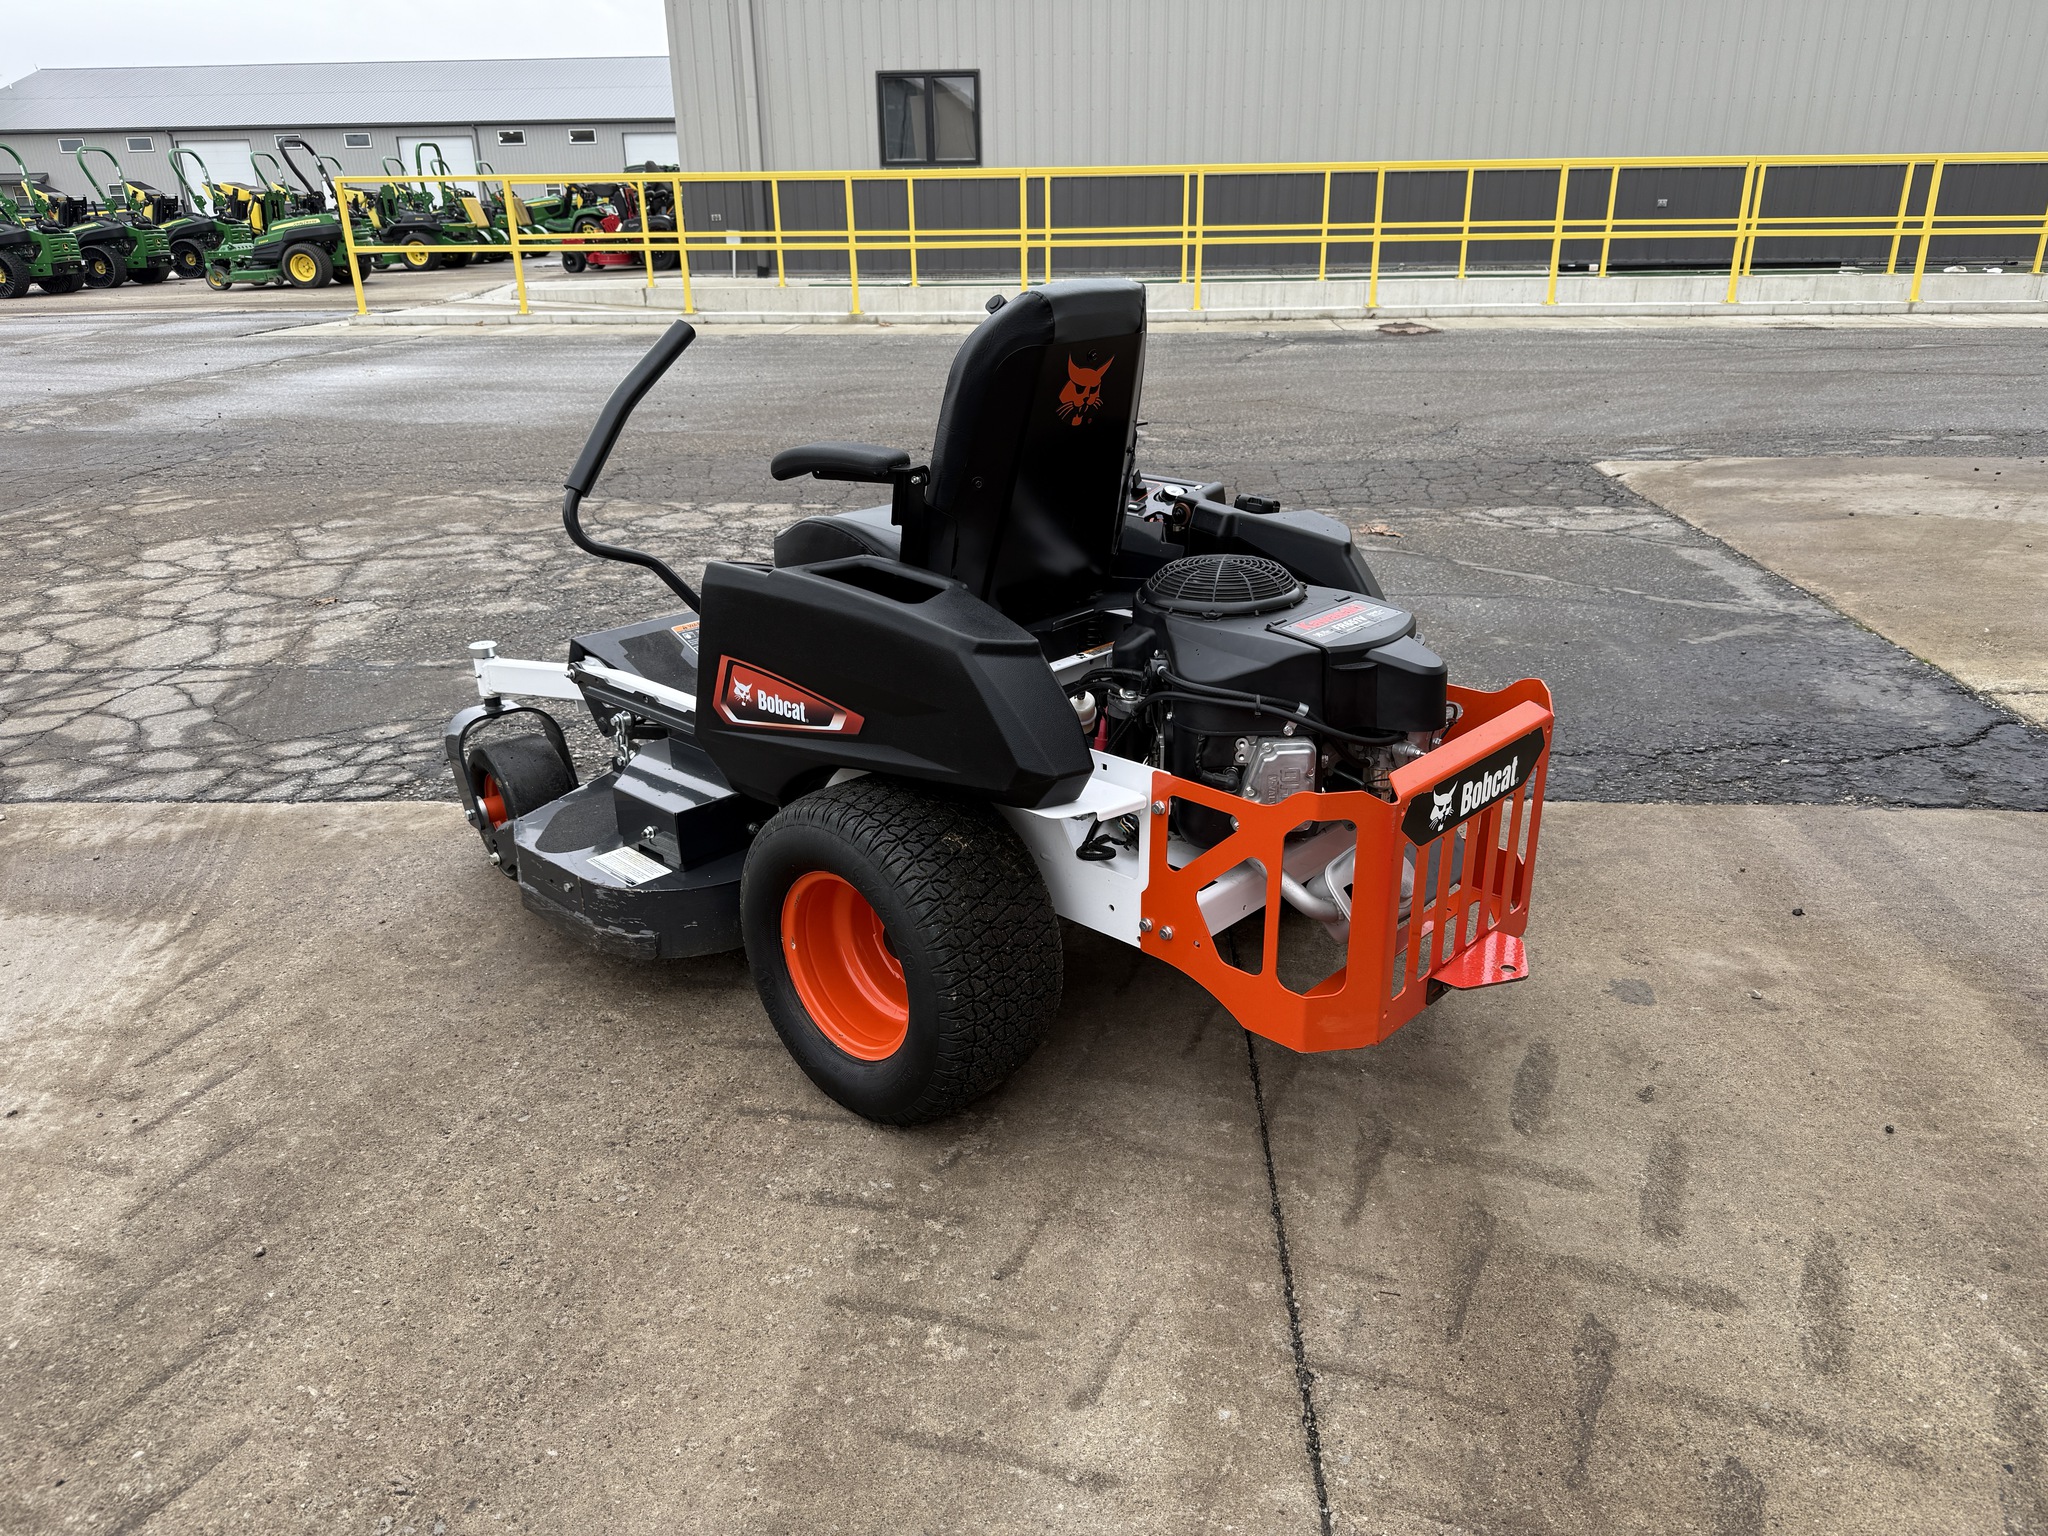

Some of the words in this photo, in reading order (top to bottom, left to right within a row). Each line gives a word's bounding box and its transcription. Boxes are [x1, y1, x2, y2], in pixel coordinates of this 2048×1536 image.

[1295, 604, 1366, 631] Kawasaki
[757, 689, 806, 722] Bobcat
[1460, 755, 1519, 817] Bobcat
